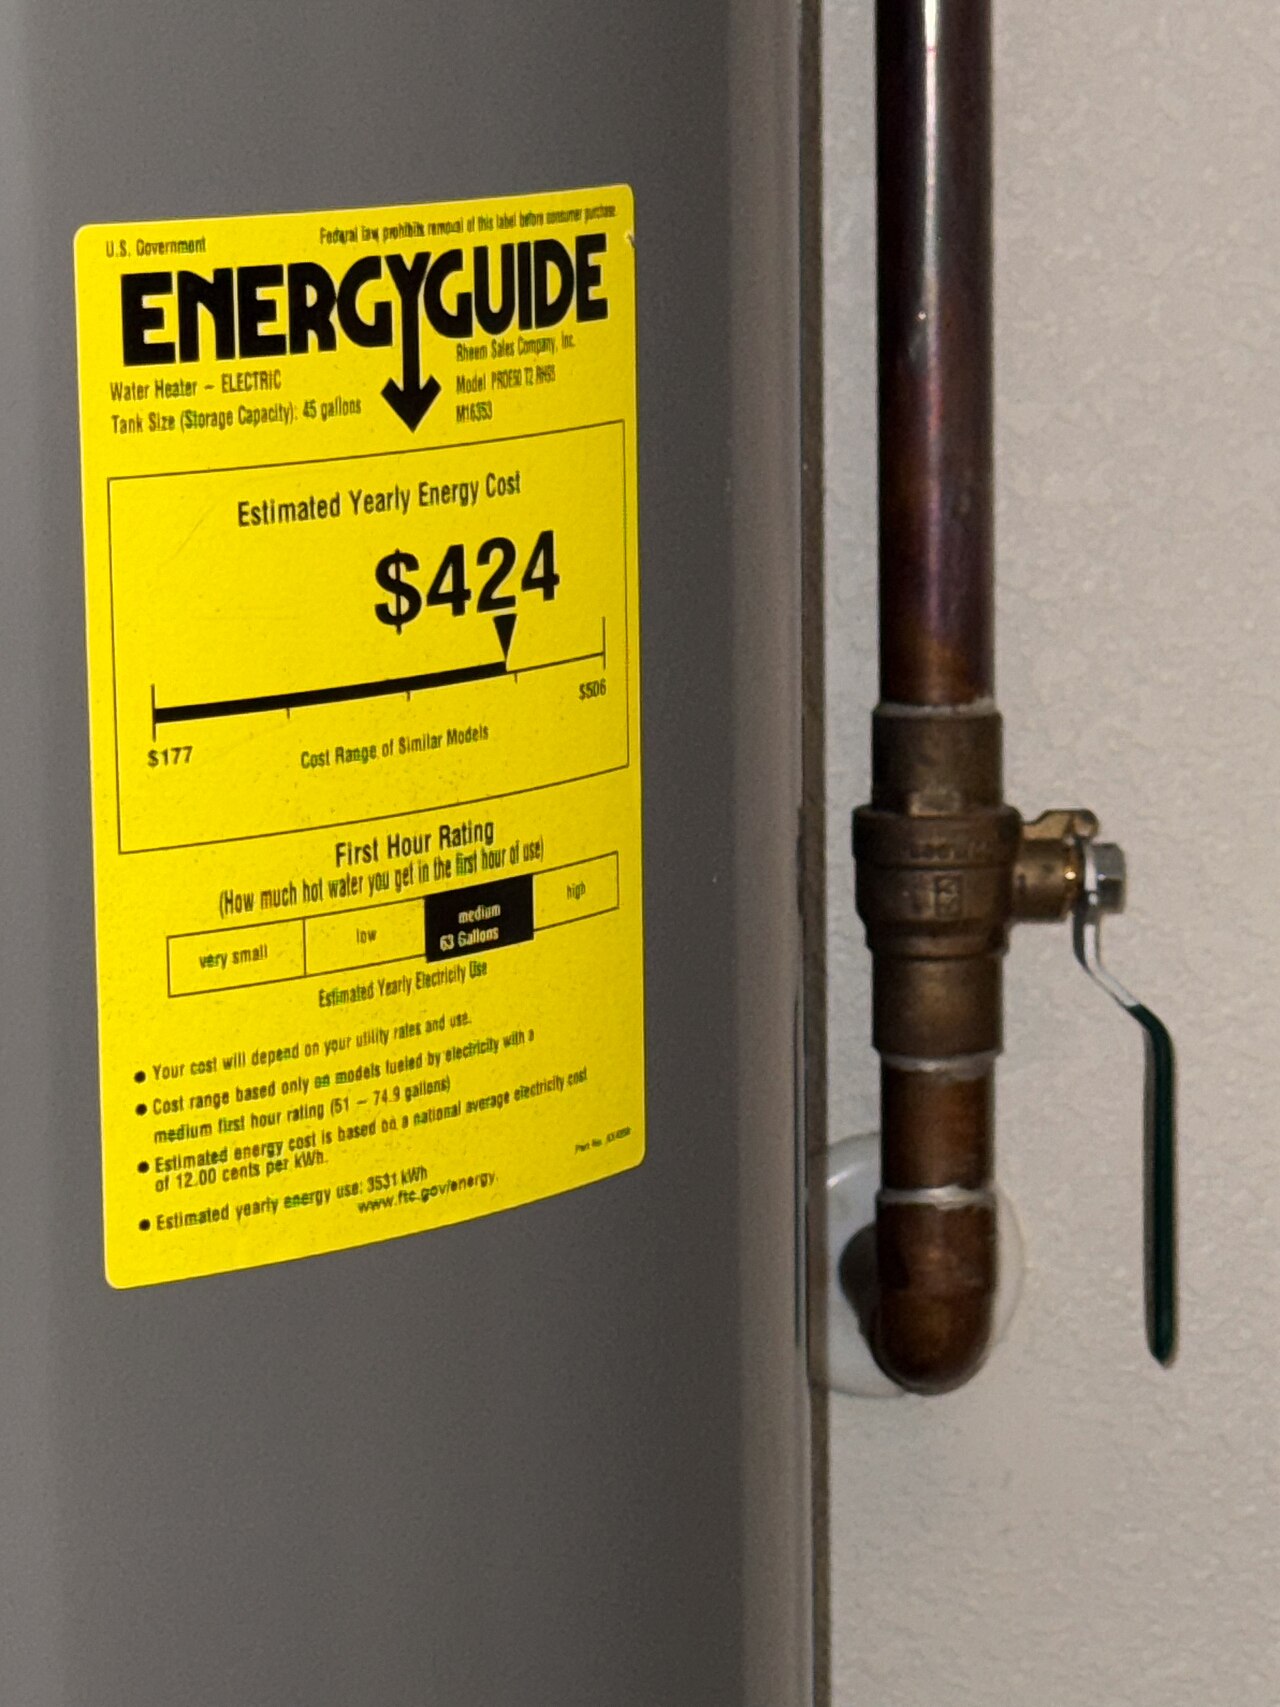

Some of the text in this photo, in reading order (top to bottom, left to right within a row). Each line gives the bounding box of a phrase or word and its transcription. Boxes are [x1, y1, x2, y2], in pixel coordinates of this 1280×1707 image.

[362, 225, 380, 243] law
[383, 221, 424, 243] prohibits
[428, 216, 463, 236] removal
[467, 216, 475, 232] of
[478, 215, 493, 231] this
[496, 211, 516, 229] label
[519, 210, 544, 227] before
[136, 238, 206, 257] Government
[121, 233, 607, 366] ENERGYGUIDE
[456, 344, 488, 361] Rheem
[491, 339, 514, 359] Sales
[110, 382, 150, 401] Water
[155, 379, 197, 398] Heater
[221, 369, 281, 393] ELECTRIC
[456, 373, 486, 394] Model
[111, 395, 361, 434] Tank Size (Storage Capacity): 45 gallons
[238, 471, 521, 527] Estimated Yearly Energy Cost
[375, 530, 560, 635] $424
[578, 678, 607, 701] $506
[148, 746, 192, 767] $177
[301, 725, 489, 769] Cost Range of Similar Models
[335, 821, 494, 868] First Hour Rating
[219, 836, 545, 918] (How much hot water you get in the first hour of use)
[566, 880, 586, 901] high
[458, 903, 501, 923] medium
[356, 927, 377, 944] low
[440, 926, 499, 950] 63 Gallons
[198, 944, 268, 971] very small
[319, 960, 488, 1008] Estimated Yearly Electricity Use
[153, 1063, 185, 1080] Your
[190, 1058, 217, 1075] cost
[223, 1052, 246, 1069] will
[252, 1043, 299, 1066] depend
[304, 1041, 319, 1056] on
[324, 1036, 352, 1056] your
[356, 1028, 389, 1048] utility
[394, 1022, 422, 1039] rates
[425, 1015, 445, 1033] and
[153, 1029, 535, 1115] Cost range based only on models fueled by electricity with a
[154, 1122, 212, 1144] medium
[218, 1115, 245, 1134] first
[251, 1111, 282, 1129] hour
[287, 1103, 324, 1124] rating
[330, 1096, 350, 1118] (51
[405, 1075, 451, 1102] gallons)
[155, 1066, 587, 1173] Estimated energy cost is based on a national average electricity cost
[155, 1177, 170, 1192] of
[176, 1168, 217, 1189] 12.00
[222, 1162, 261, 1182] cents
[266, 1159, 289, 1176] per
[156, 1165, 428, 1231] Estimated yearly energy use: 3531 kWh
